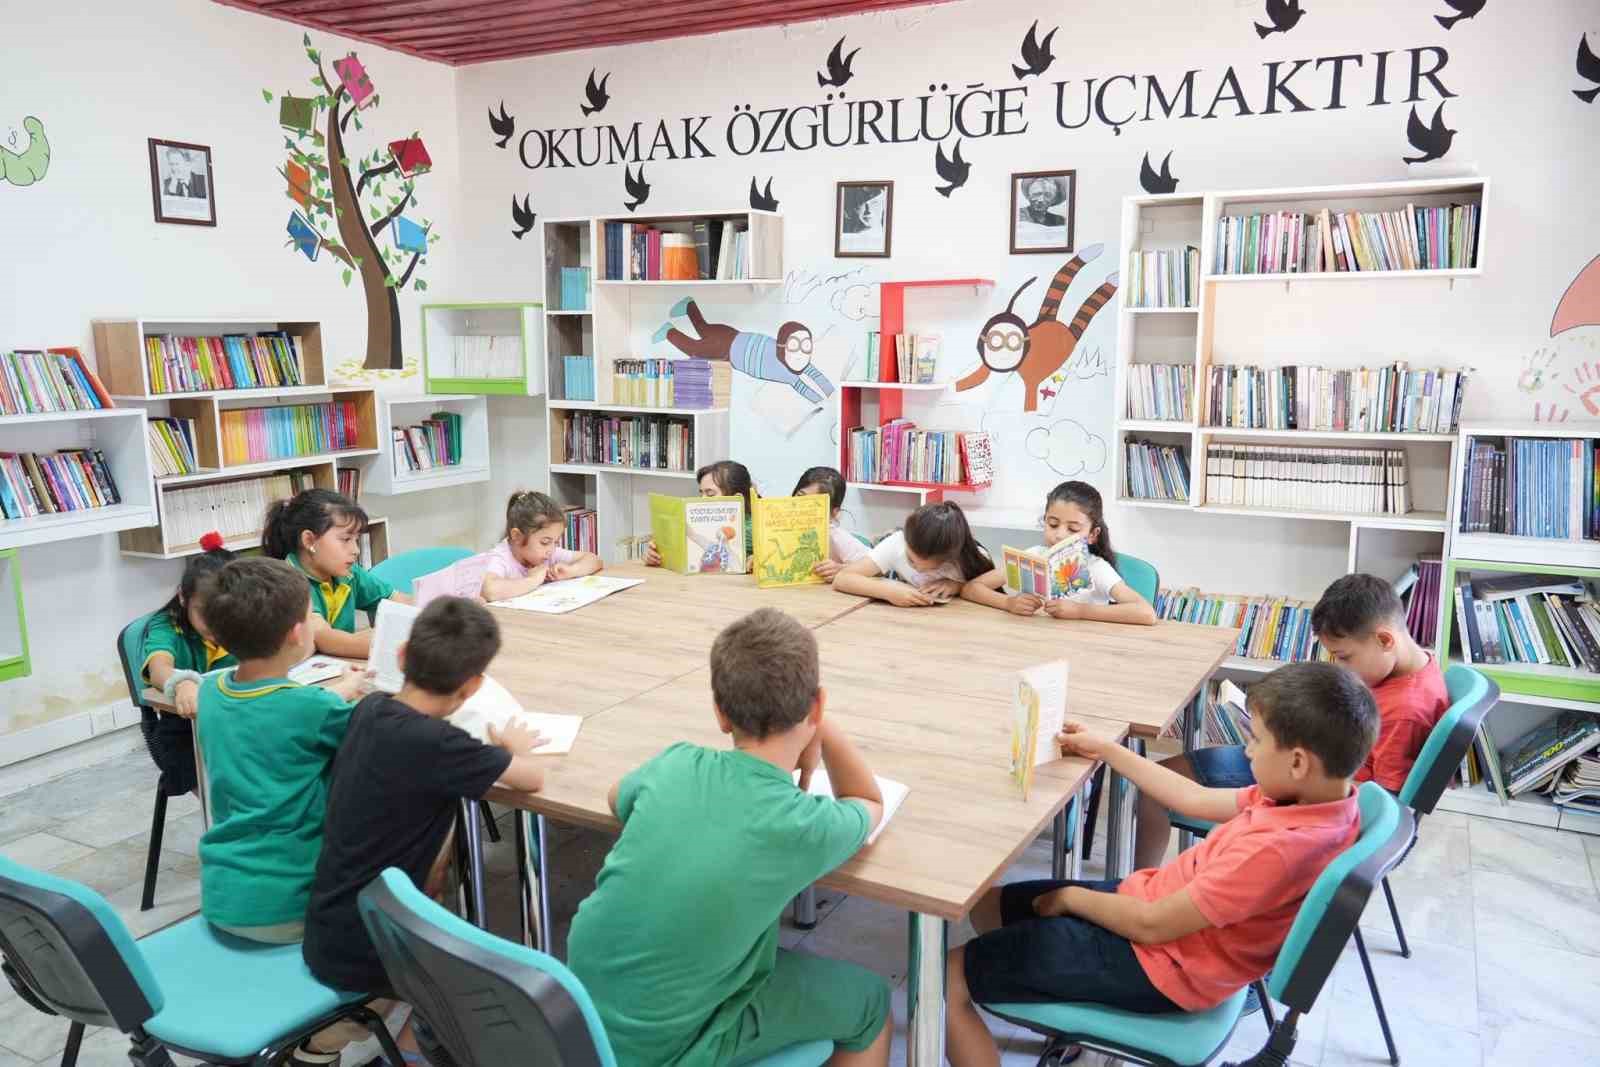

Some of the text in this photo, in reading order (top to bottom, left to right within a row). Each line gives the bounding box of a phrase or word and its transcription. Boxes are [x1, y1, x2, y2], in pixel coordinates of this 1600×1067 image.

[519, 45, 1459, 169] OKUMAK ÖZGÜRLÜĞE UÇMAKTIR
